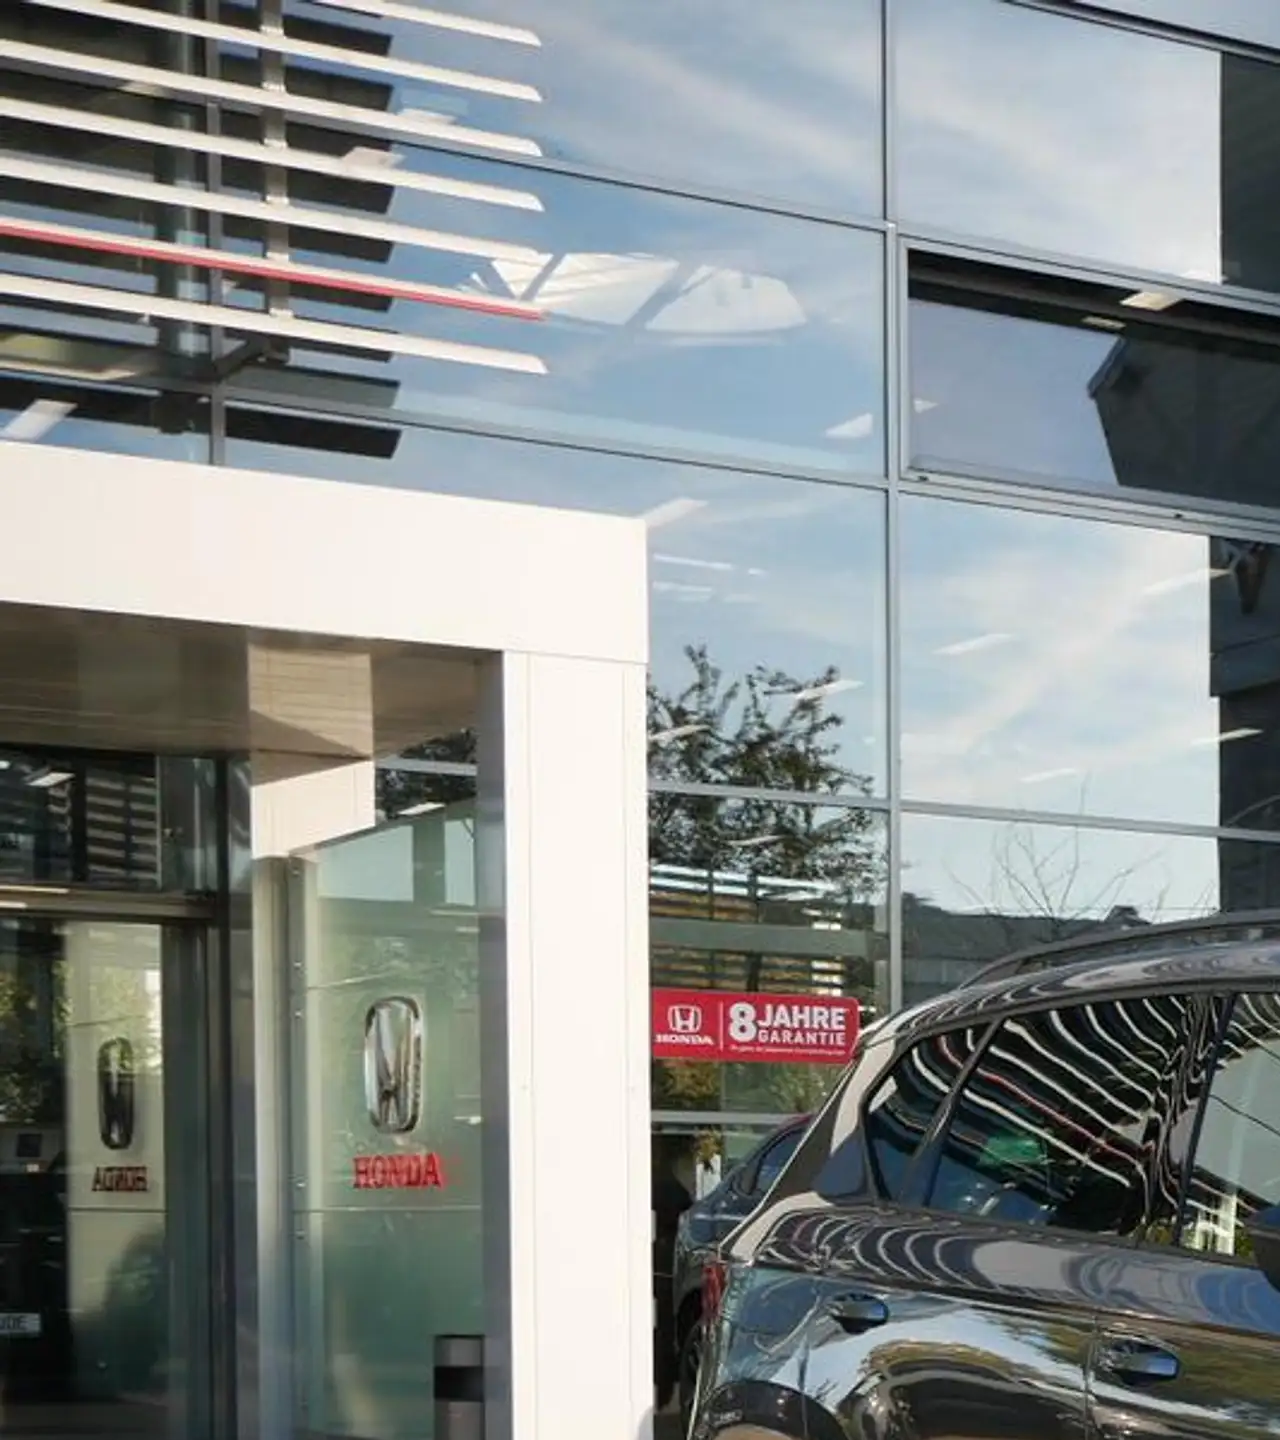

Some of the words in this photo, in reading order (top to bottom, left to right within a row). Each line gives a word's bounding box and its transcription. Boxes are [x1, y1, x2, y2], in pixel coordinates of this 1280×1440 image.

[728, 1001, 757, 1043] 8
[757, 1003, 847, 1030] JAHRE
[655, 1034, 714, 1046] HONDA
[758, 1031, 847, 1046] GARANTIE
[353, 1152, 442, 1189] HONDA
